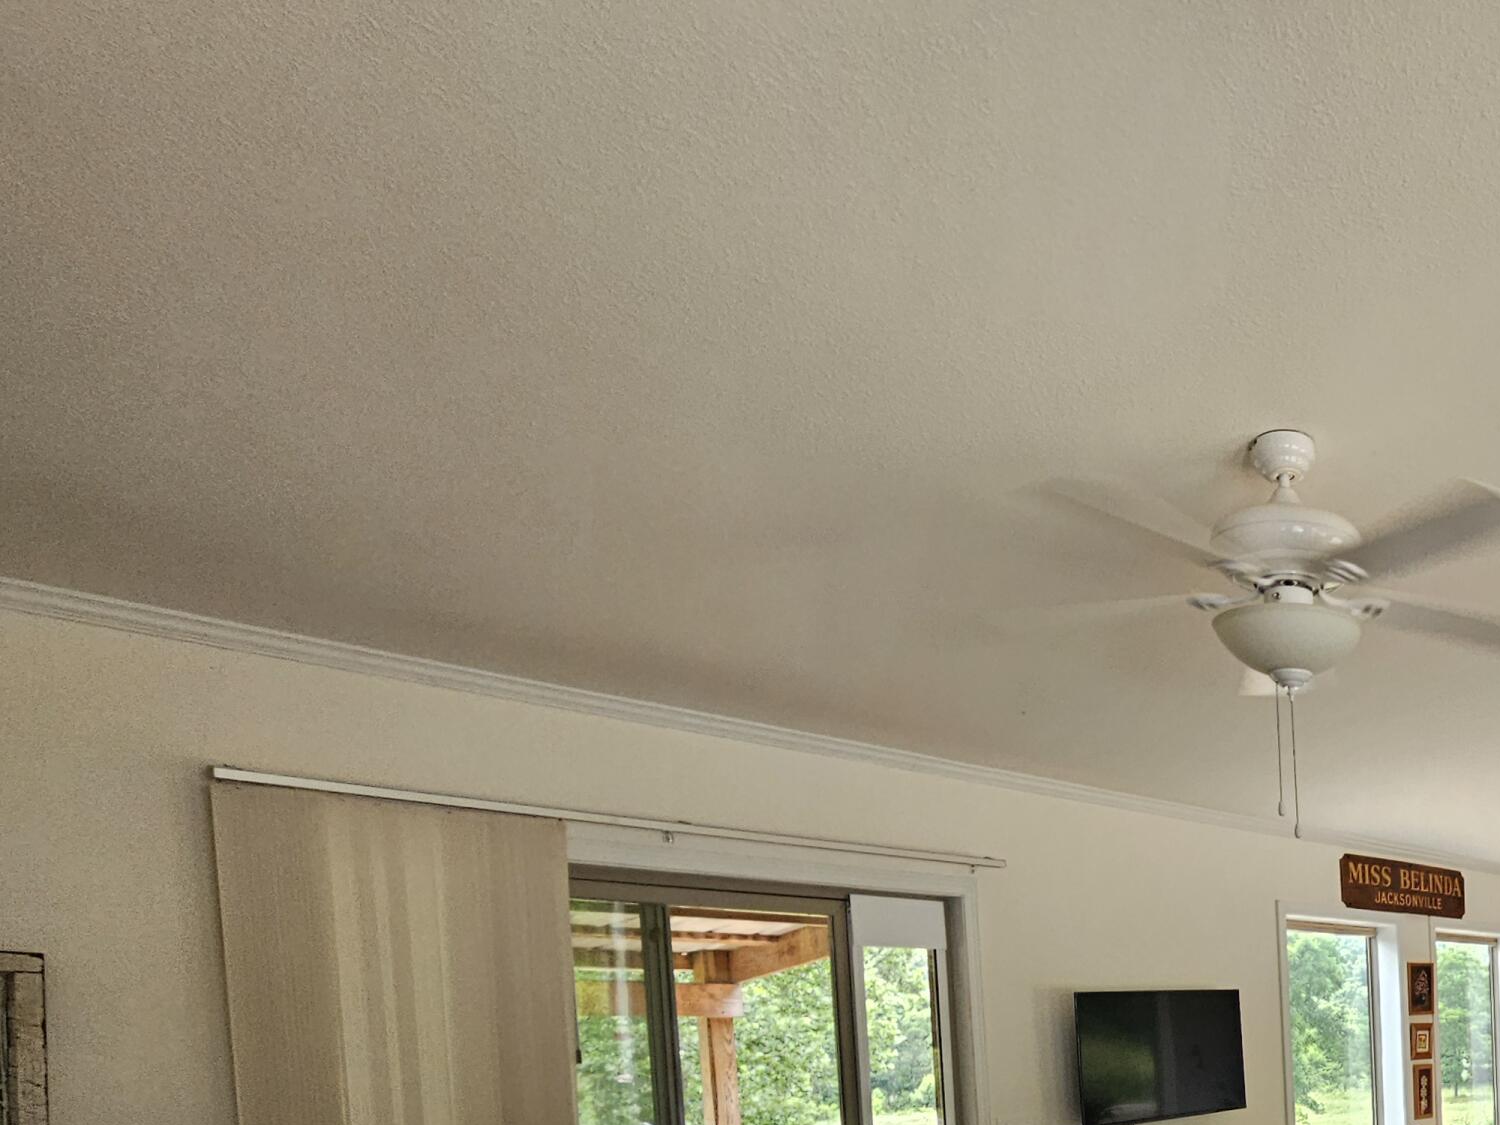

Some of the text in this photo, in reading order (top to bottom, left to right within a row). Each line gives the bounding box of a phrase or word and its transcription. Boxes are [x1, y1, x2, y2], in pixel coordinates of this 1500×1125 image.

[1348, 861, 1462, 898] MISS BELINDA
[1375, 891, 1443, 911] JACKSONVILLE
